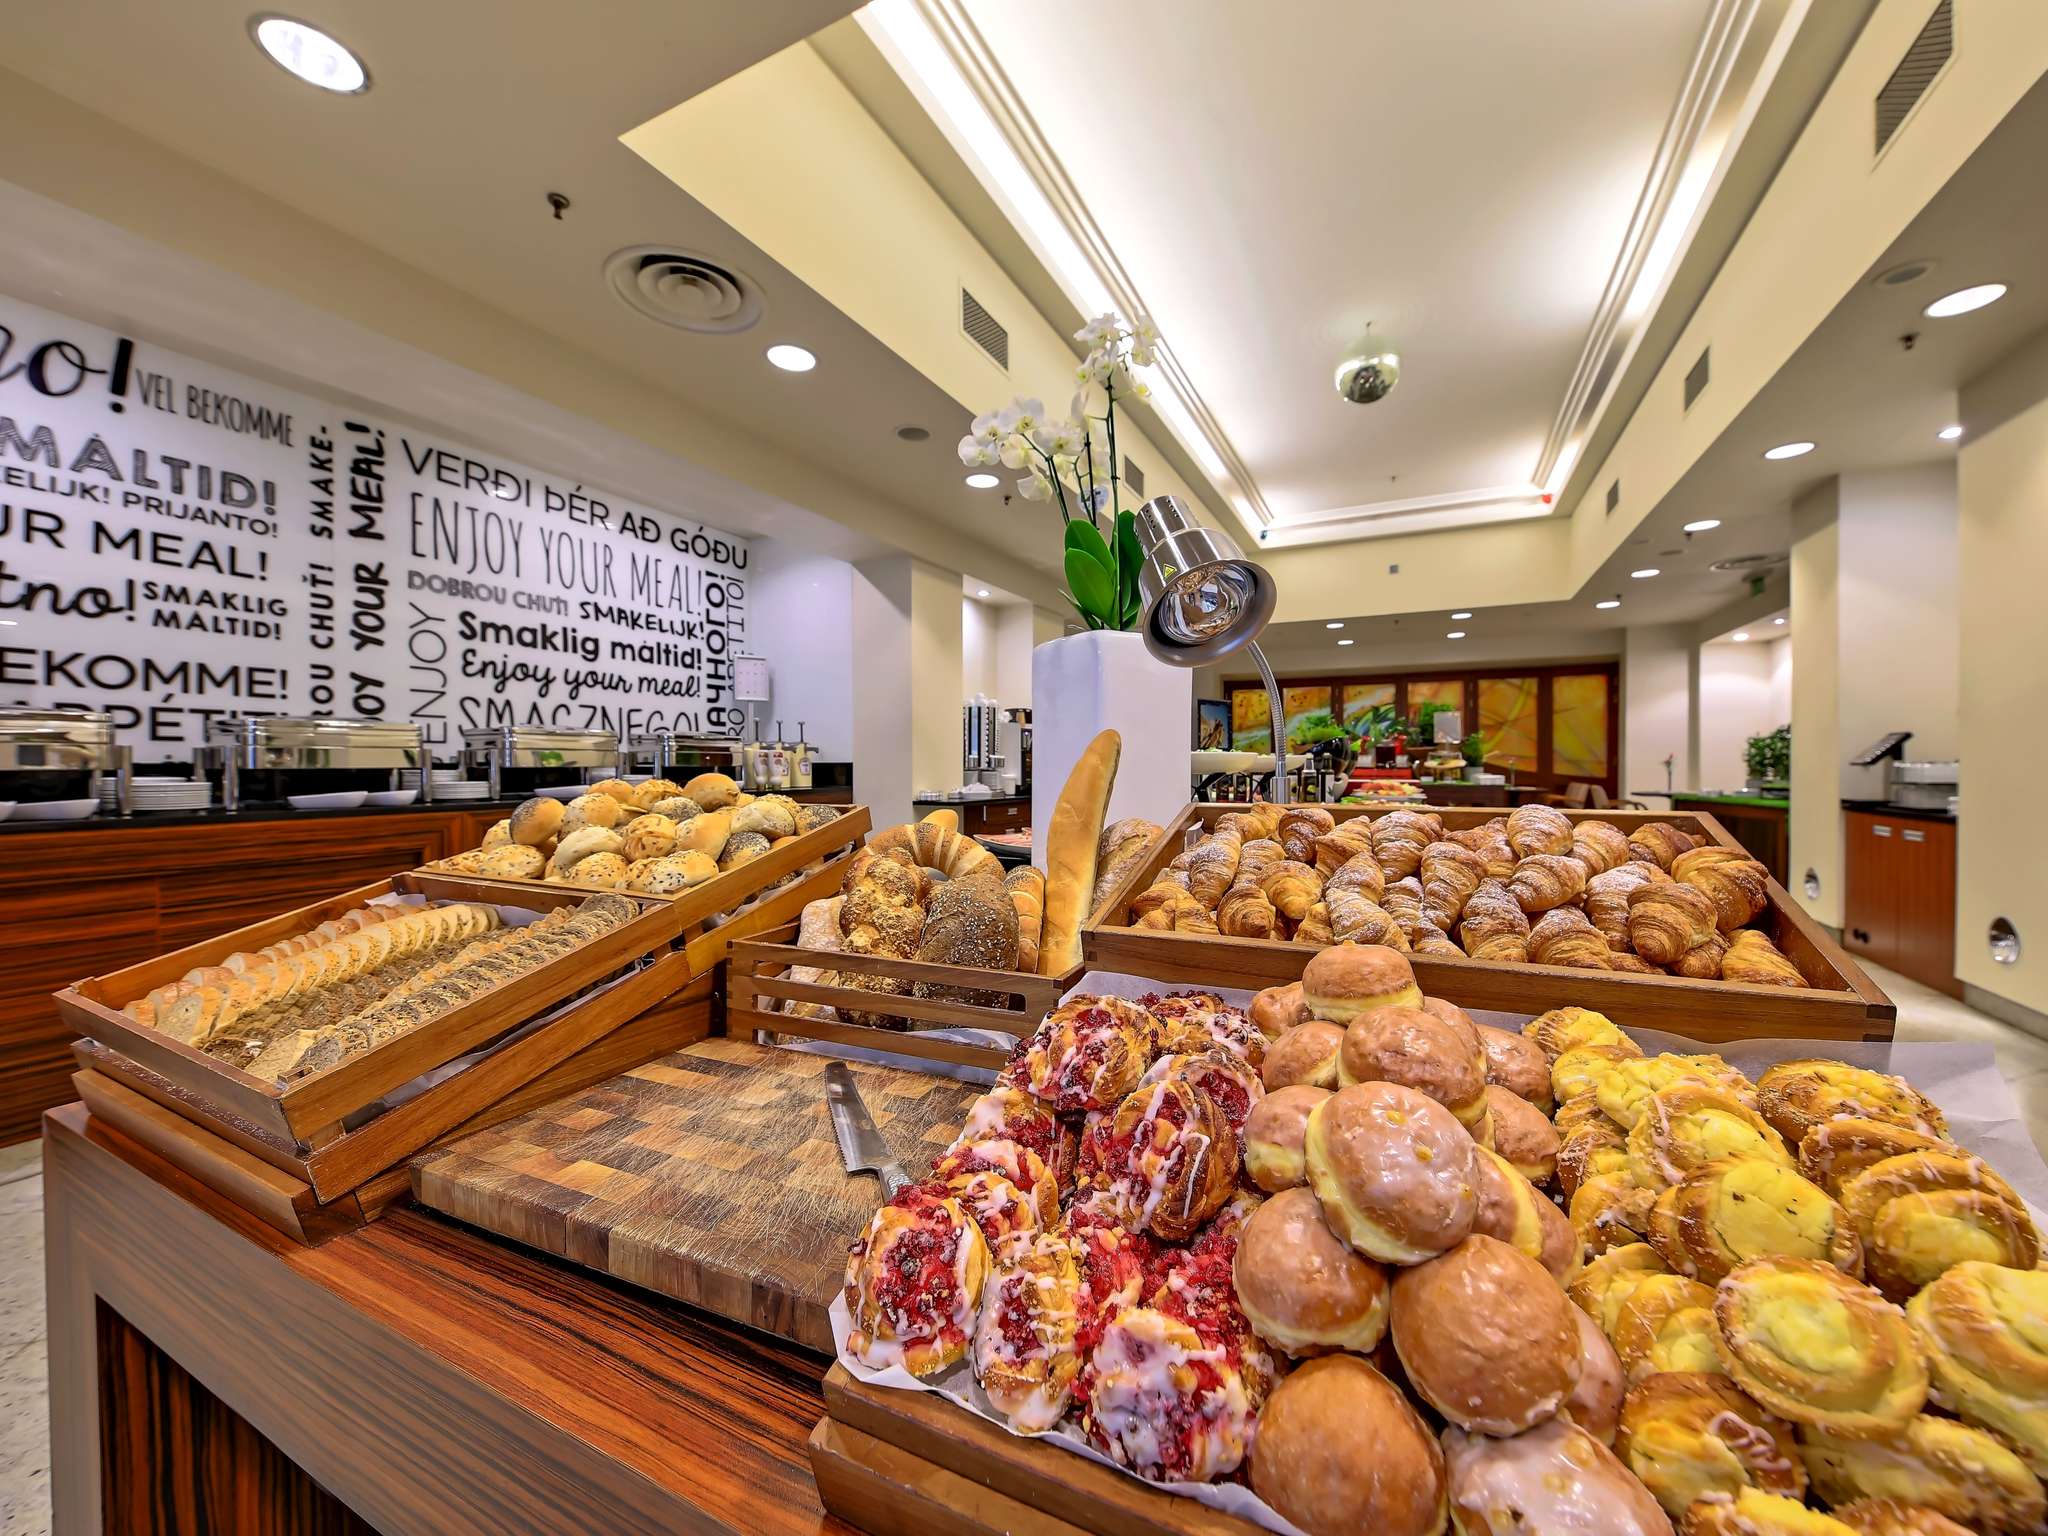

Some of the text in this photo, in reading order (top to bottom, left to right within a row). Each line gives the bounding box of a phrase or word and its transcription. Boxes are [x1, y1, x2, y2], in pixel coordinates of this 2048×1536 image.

[135, 368, 295, 448] VEL BEKOMME
[0, 465, 278, 538] ELIJK! PRIJANTO!
[92, 520, 269, 581] MEAL!
[344, 421, 389, 721] OY YOUR MEAL!
[410, 492, 702, 617] ENJOY YOUR MEAL!
[142, 581, 288, 617] SMAKLIG
[408, 570, 507, 604] DOBROU
[152, 608, 282, 640] MALTID!
[458, 611, 600, 662] Smaklig
[579, 600, 705, 640] SMAKELIJK!
[0, 646, 289, 700] EKOMME!
[409, 602, 447, 744] ENJOY
[461, 648, 701, 699] Enjoy your meal!
[705, 570, 728, 738] АЧНОГО!
